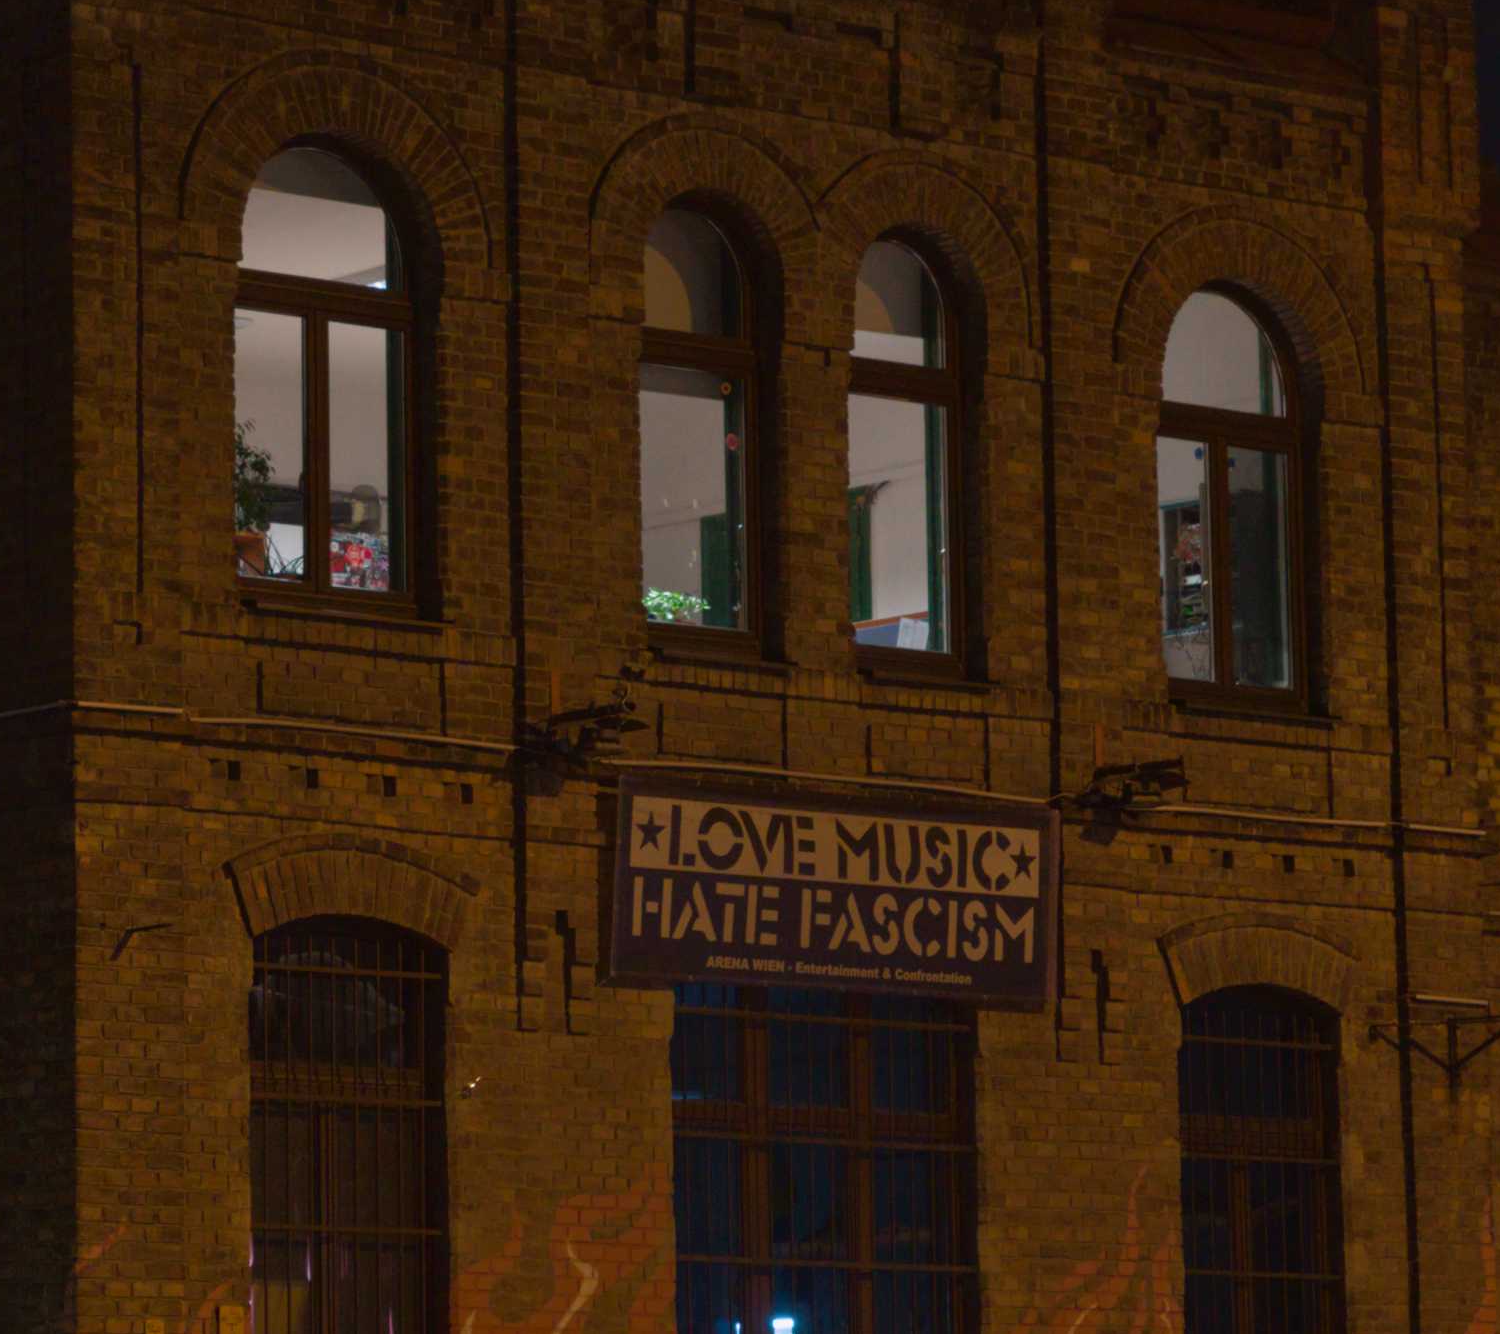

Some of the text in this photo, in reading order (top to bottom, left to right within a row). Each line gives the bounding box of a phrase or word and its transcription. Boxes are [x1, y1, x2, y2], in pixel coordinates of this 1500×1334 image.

[668, 804, 1012, 892] LOVE MUSIC
[631, 875, 1035, 964] HATE FASCISM
[705, 954, 750, 971] ARENA
[752, 958, 785, 973] WIEN
[795, 961, 880, 980] Entertainment
[881, 967, 892, 980] &
[895, 969, 973, 986] Confrontation
